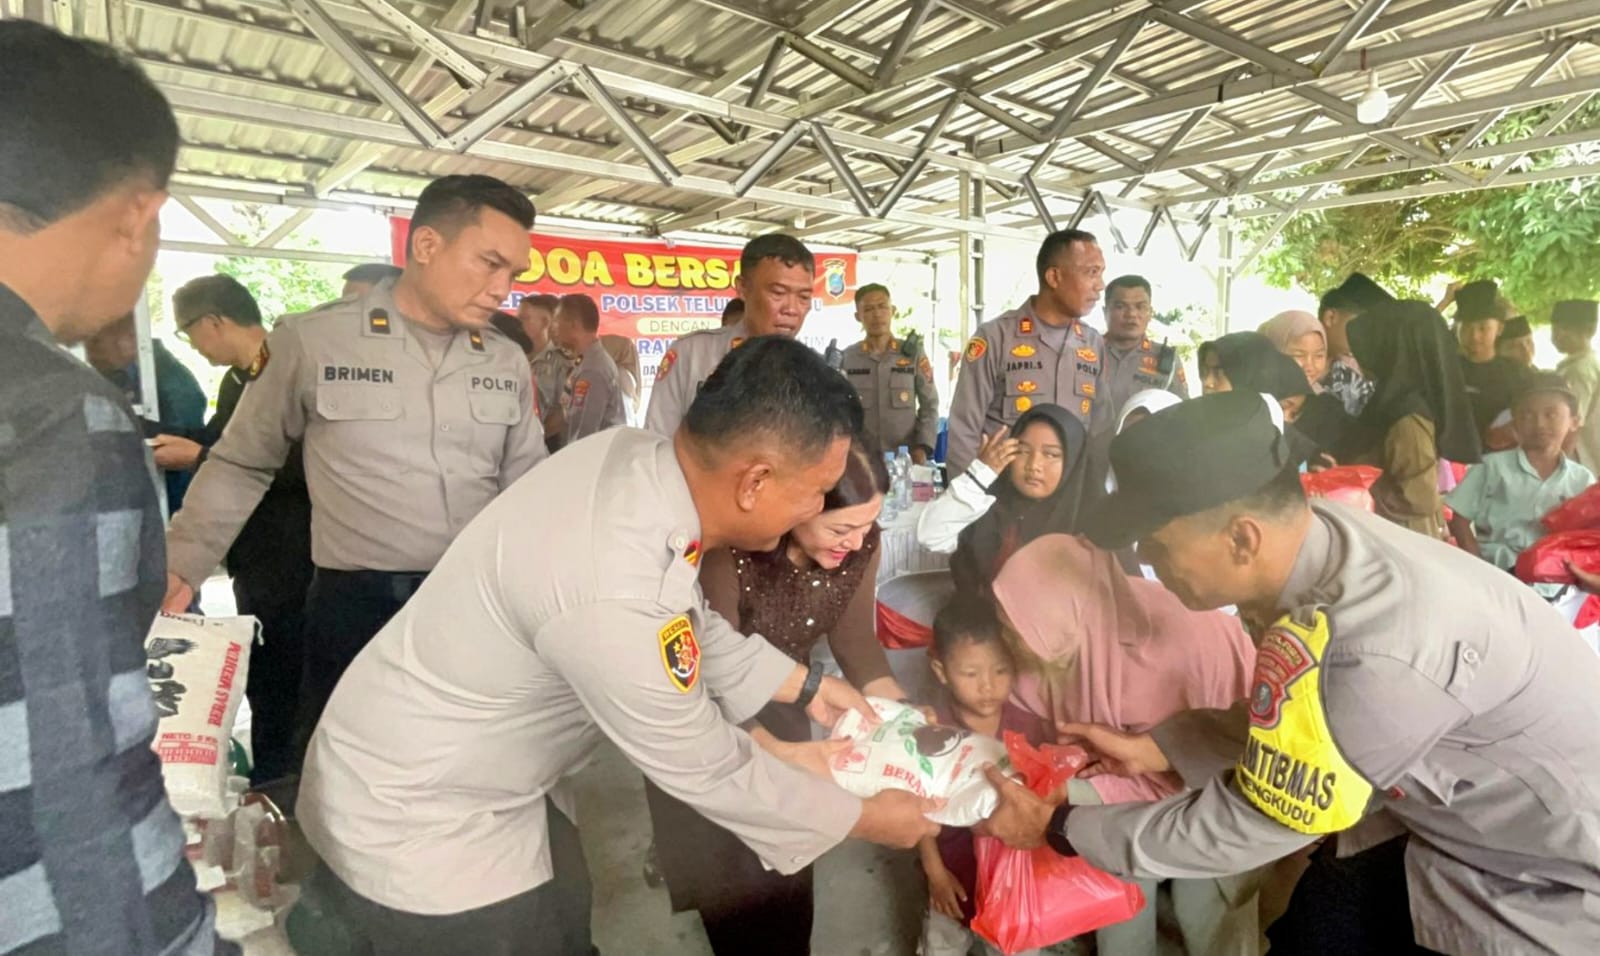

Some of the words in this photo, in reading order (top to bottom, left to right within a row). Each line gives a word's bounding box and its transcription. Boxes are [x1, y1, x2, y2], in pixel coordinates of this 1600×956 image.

[602, 295, 679, 311] POLSEK
[683, 296, 731, 312] TELU
[324, 366, 393, 384] BRIMEN
[472, 377, 517, 393] POLRI
